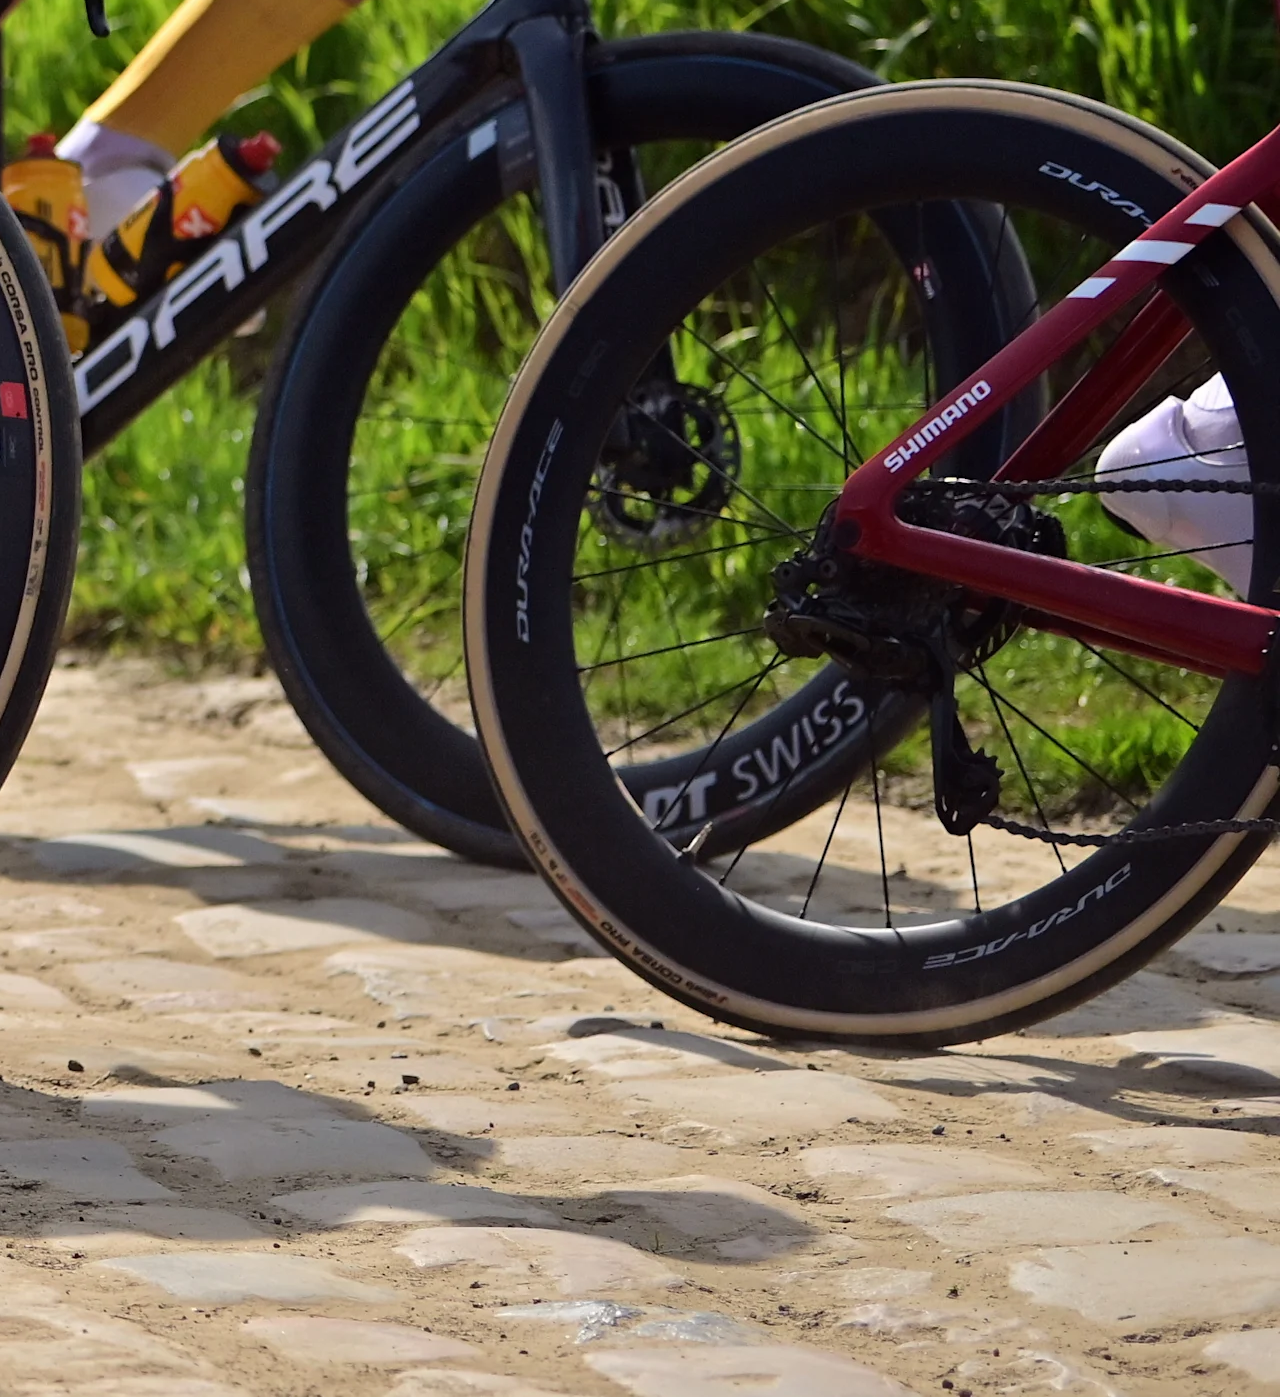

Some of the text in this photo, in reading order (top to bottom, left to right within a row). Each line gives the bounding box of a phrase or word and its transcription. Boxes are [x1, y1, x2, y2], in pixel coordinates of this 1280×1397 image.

[73, 79, 421, 418] DARE
[23, 340, 38, 382] PRO
[883, 379, 992, 474] SHIMANO
[515, 417, 565, 644] DURA-ACE
[643, 680, 865, 829] DT SWISS
[922, 862, 1132, 971] DURA-ACE
